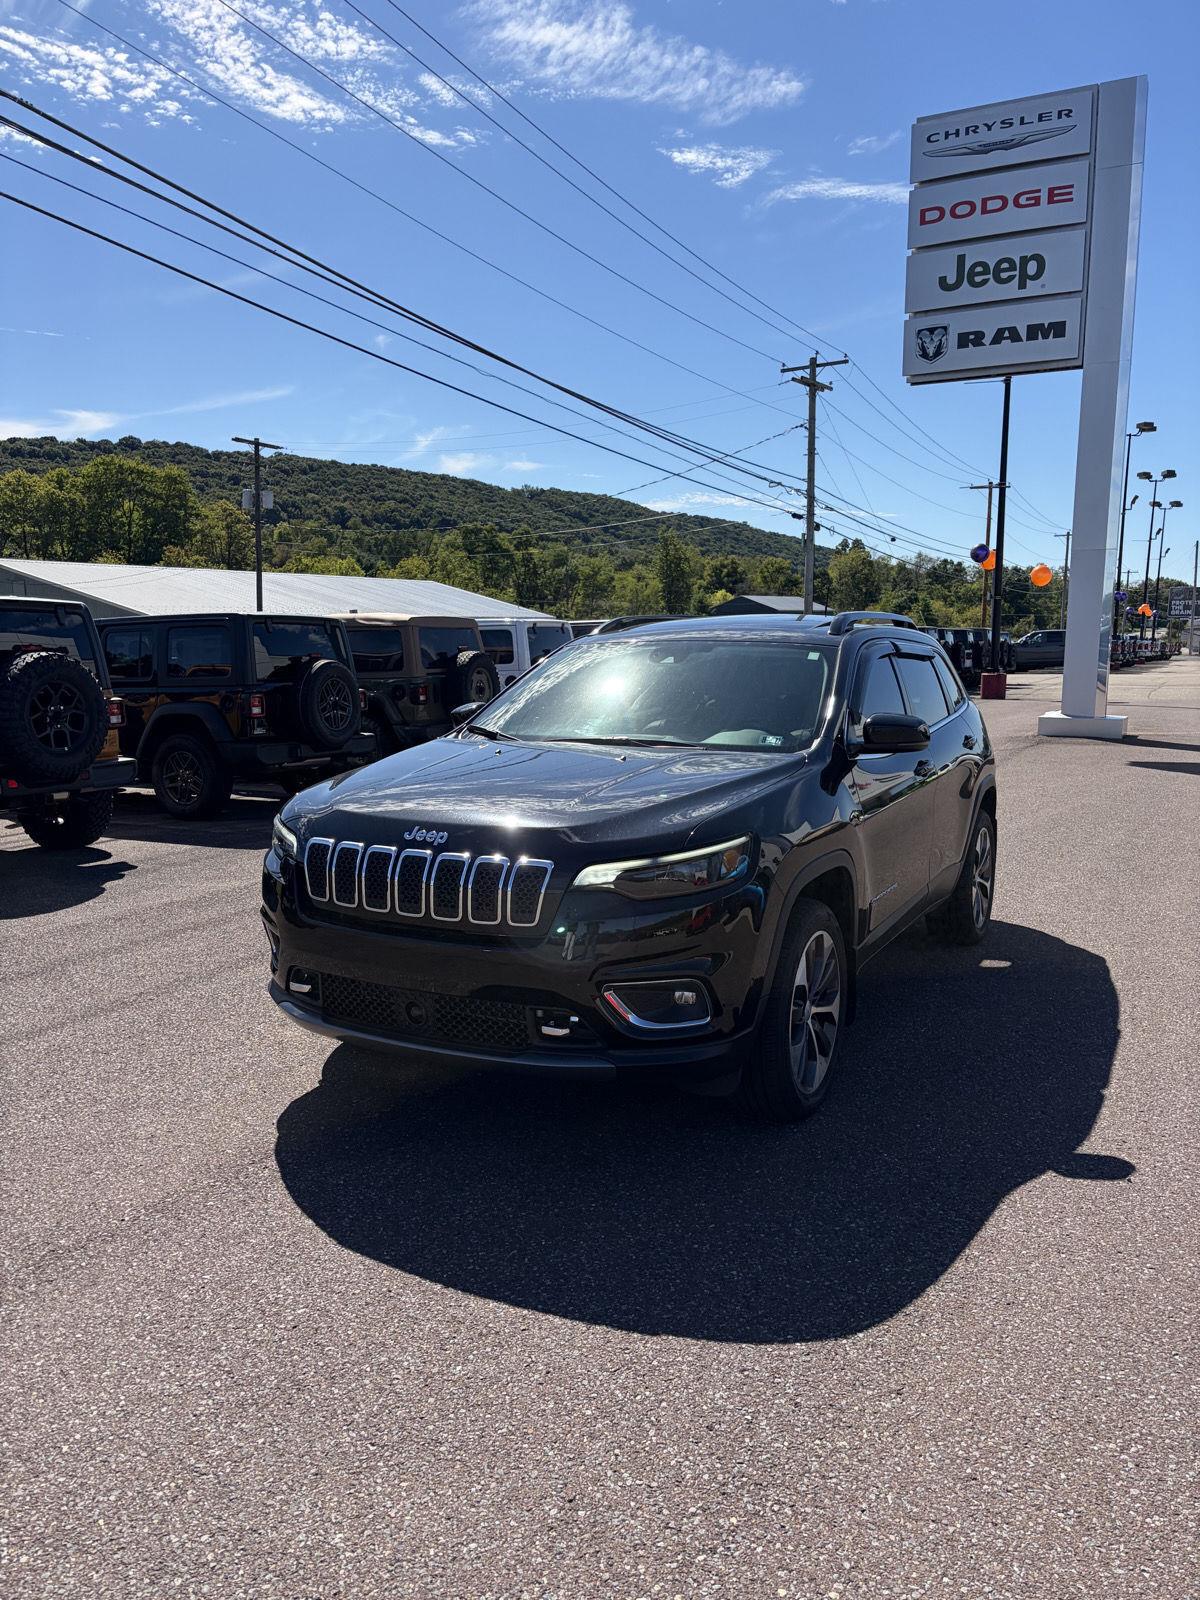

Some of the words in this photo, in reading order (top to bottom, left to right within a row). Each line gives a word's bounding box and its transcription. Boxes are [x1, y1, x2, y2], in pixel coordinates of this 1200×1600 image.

[926, 108, 1074, 144] CHRYSLER
[919, 183, 1075, 226] DODGE
[938, 253, 1046, 292] Jeep
[956, 320, 1067, 350] RAM
[403, 825, 449, 846] Jeep
